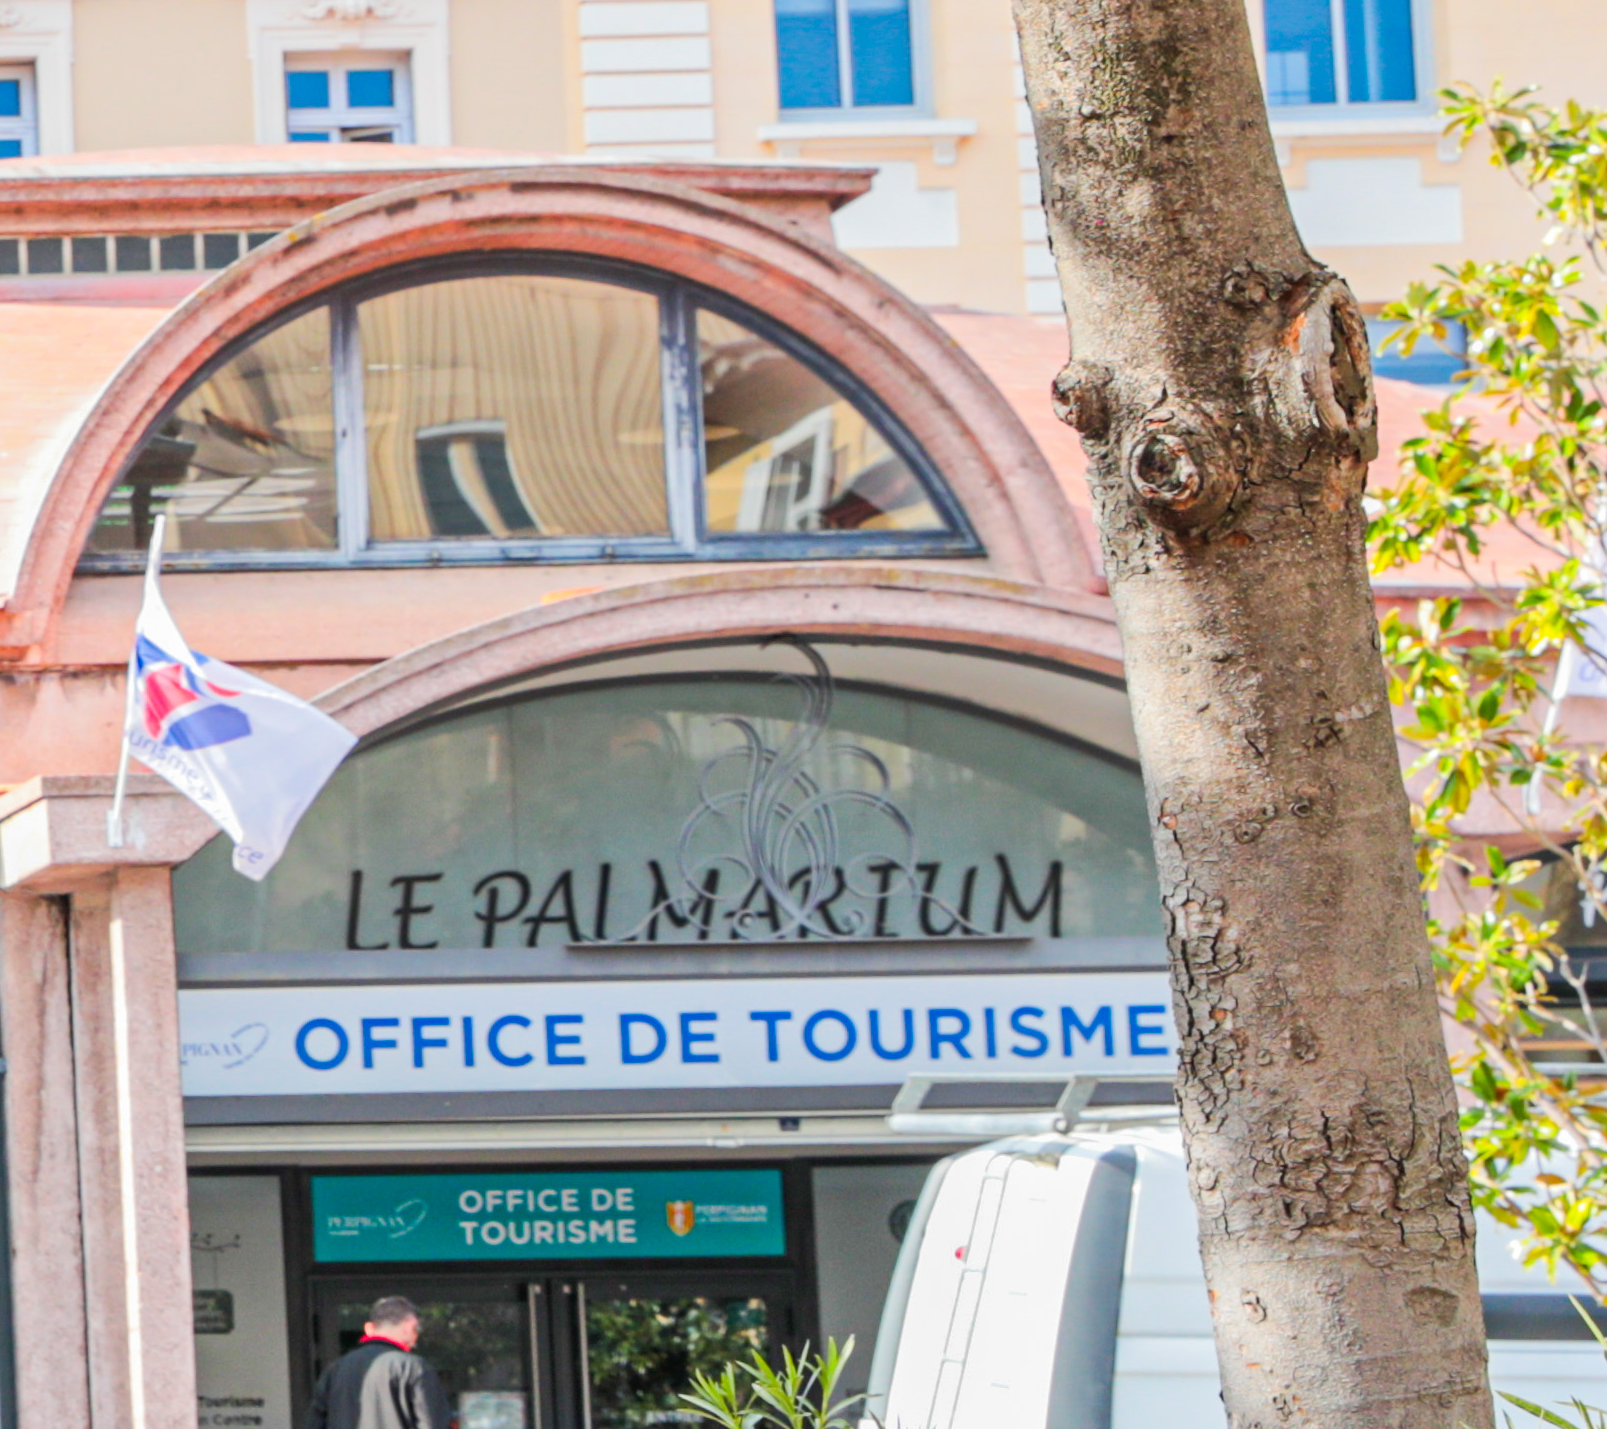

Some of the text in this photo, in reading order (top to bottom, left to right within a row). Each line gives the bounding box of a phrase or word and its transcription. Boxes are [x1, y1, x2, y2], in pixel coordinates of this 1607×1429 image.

[344, 854, 1065, 951] LE PALMARIUM
[295, 1004, 1170, 1070] OFFICE DE TOURISME
[459, 1187, 636, 1213] OFFICE DE
[459, 1219, 637, 1245] TOURISME
